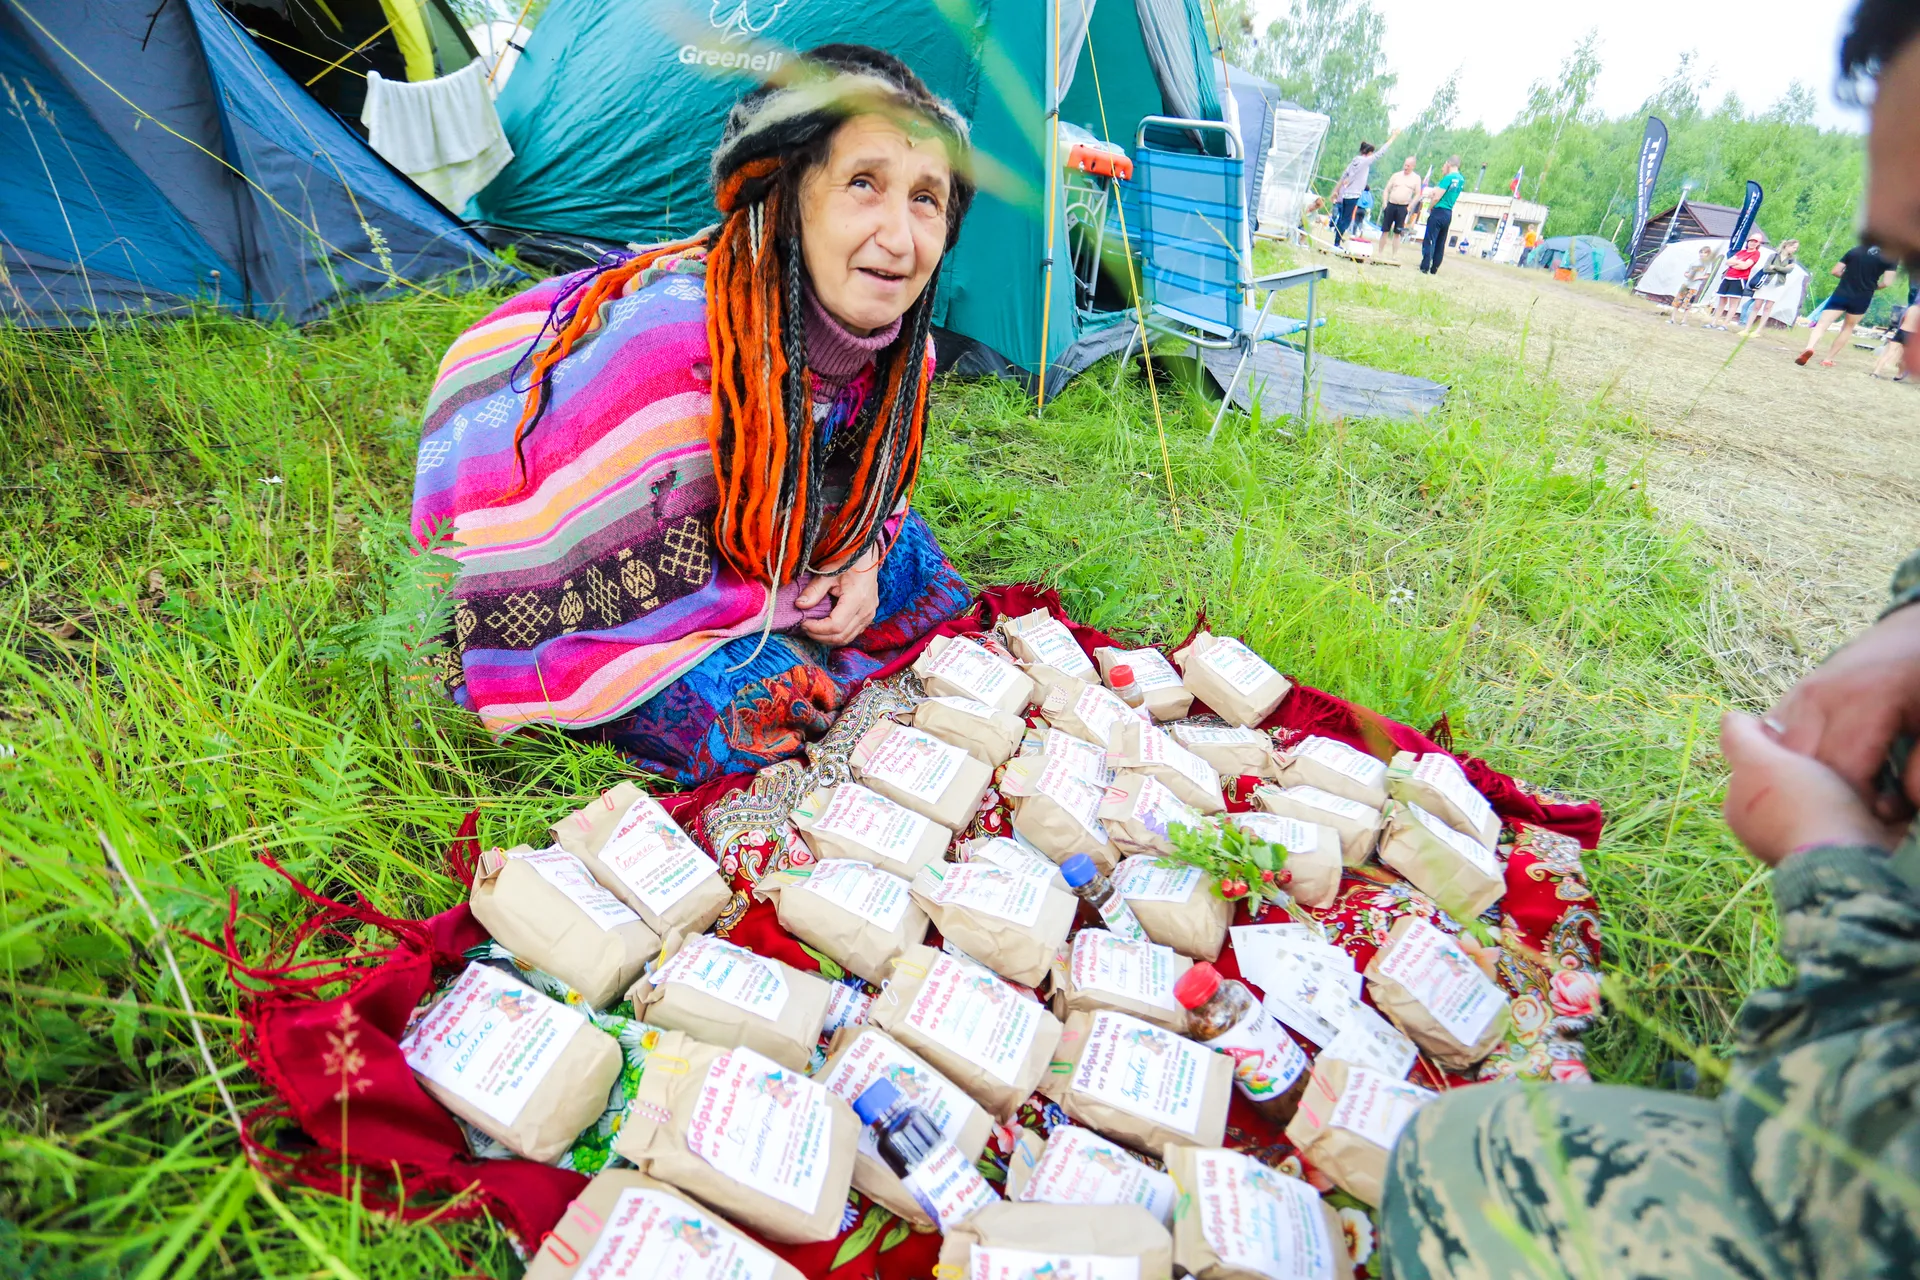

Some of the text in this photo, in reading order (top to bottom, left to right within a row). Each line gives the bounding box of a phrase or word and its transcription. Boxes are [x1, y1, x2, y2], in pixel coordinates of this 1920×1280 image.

[678, 44, 783, 72] Greenell
[910, 980, 940, 1026] Добрый
[929, 1018, 940, 1031] от
[1078, 1017, 1109, 1088] Добрый Чай
[1265, 1054, 1278, 1069] от
[1098, 1078, 1107, 1090] от
[940, 1204, 956, 1219] от
